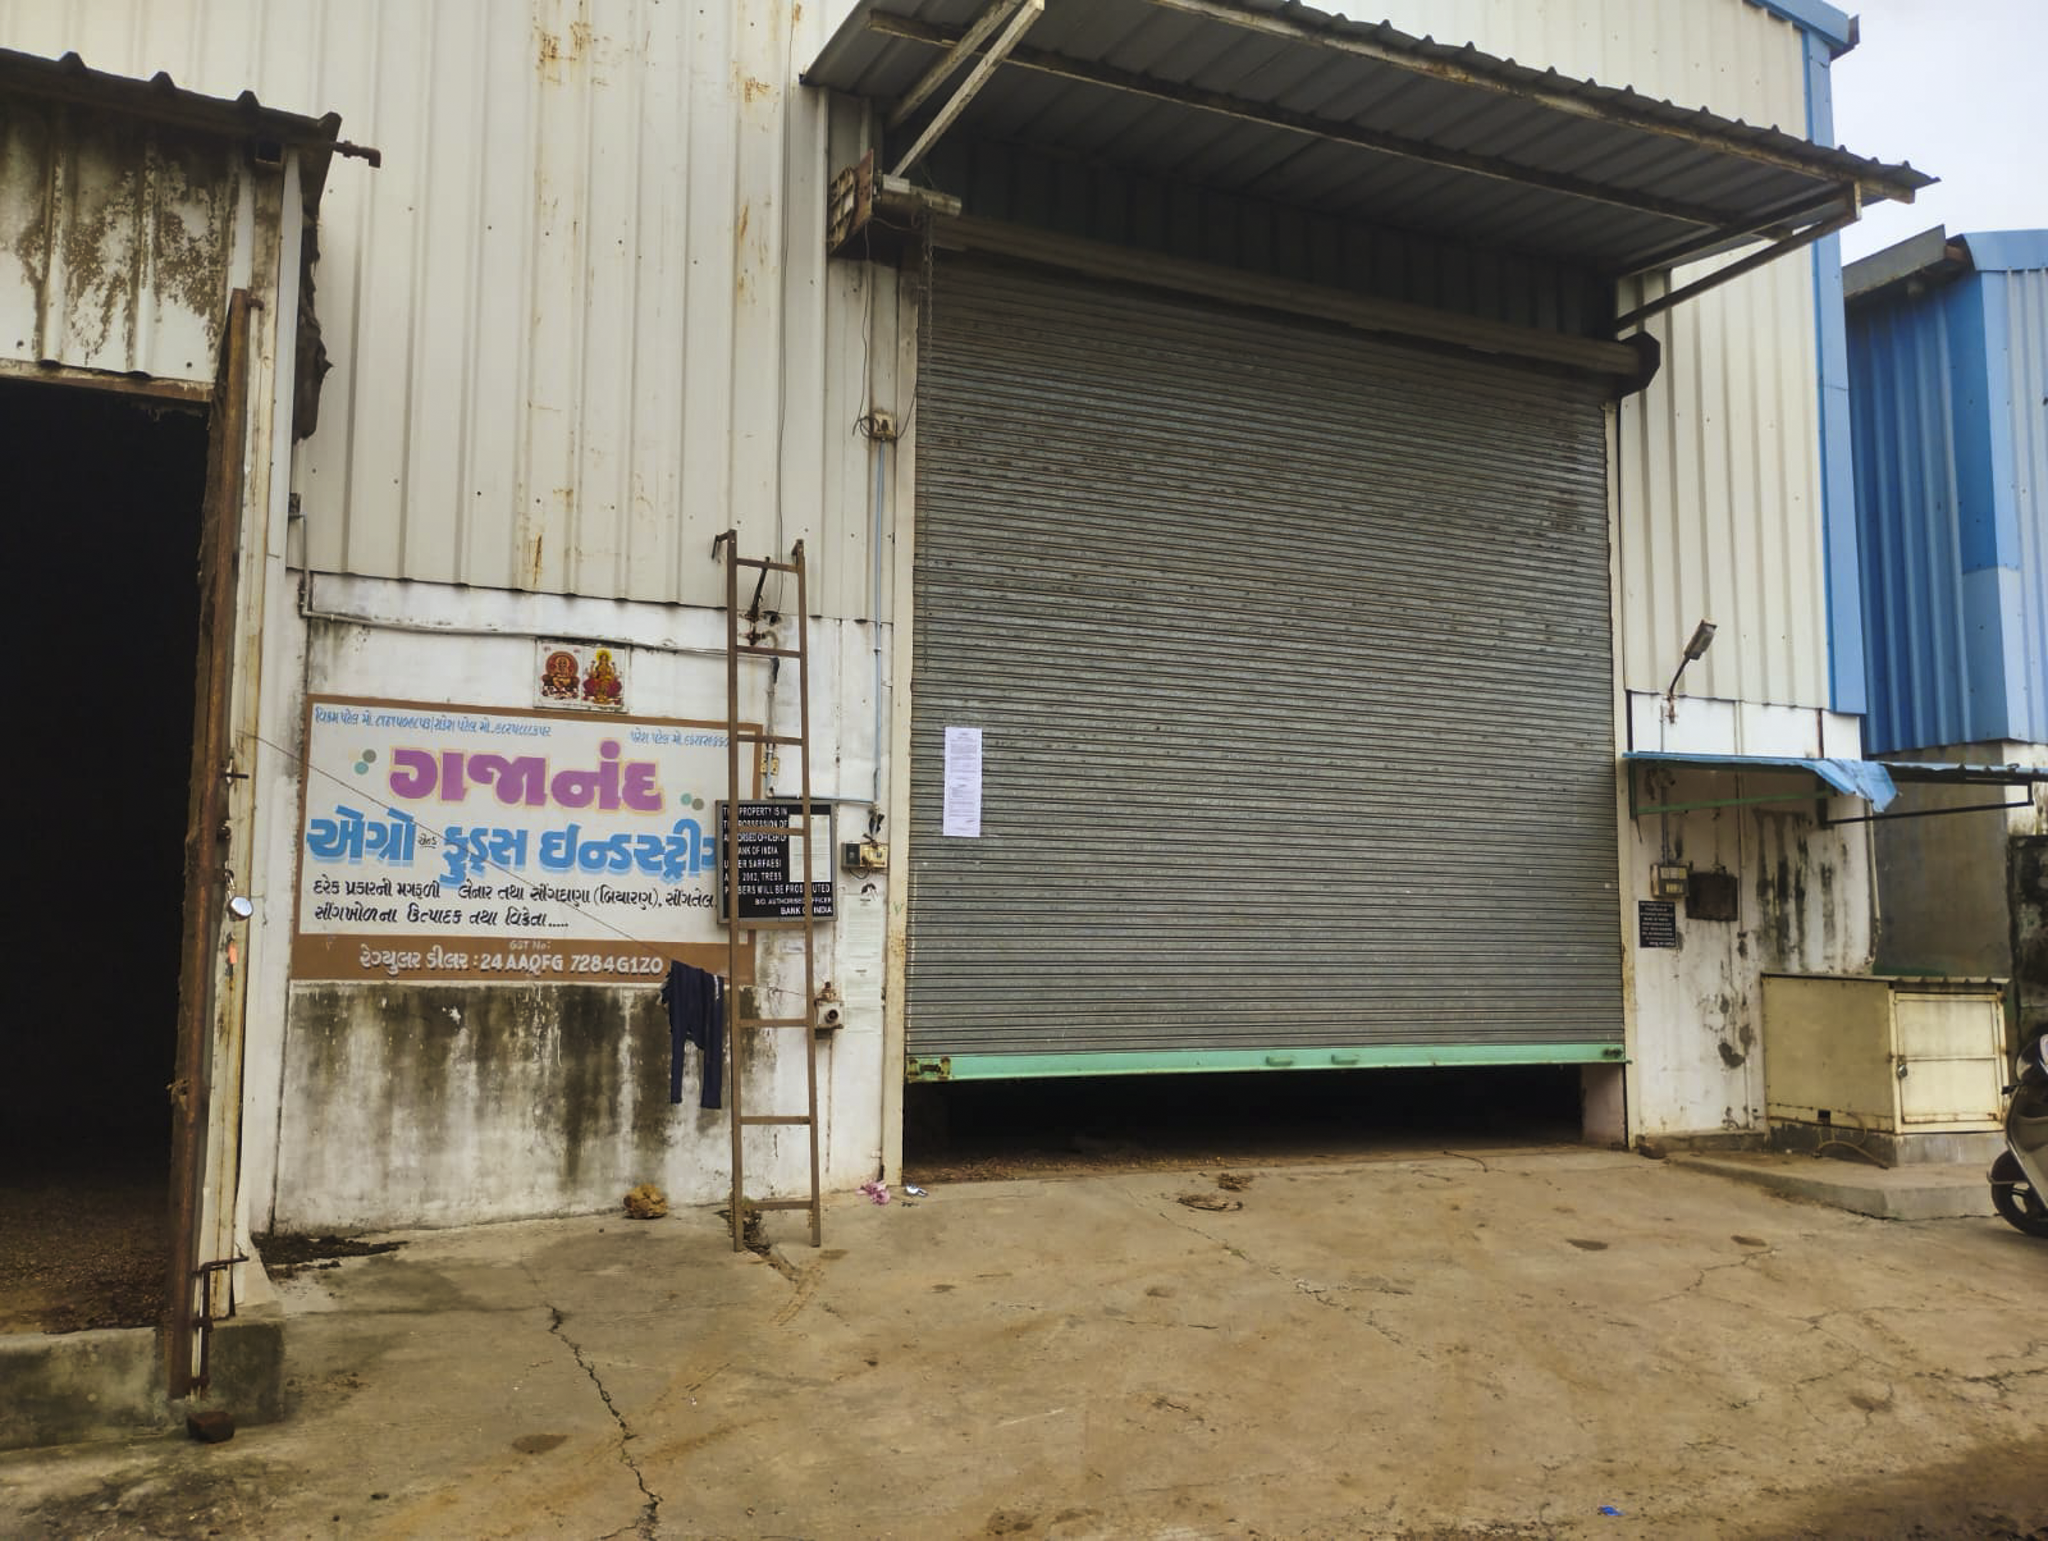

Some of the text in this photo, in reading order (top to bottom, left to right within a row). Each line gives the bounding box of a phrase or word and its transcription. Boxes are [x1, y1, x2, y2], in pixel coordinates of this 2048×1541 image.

[390, 740, 662, 811] ગજાનંદ
[739, 807, 772, 816] PROPERTY
[774, 808, 780, 816] IS
[781, 808, 788, 816] IN
[307, 805, 417, 862] એગ્રો
[738, 846, 778, 855] ANK OF INDIA
[724, 859, 747, 869] UER
[314, 874, 341, 895] દરેક
[498, 885, 525, 900] તથા
[757, 885, 774, 895] WILL
[774, 884, 784, 894] BE
[780, 906, 801, 915] BANK
[813, 905, 833, 914] INDIA
[469, 910, 498, 926] તથા
[510, 940, 529, 951] GST
[426, 944, 468, 970] ડીલર
